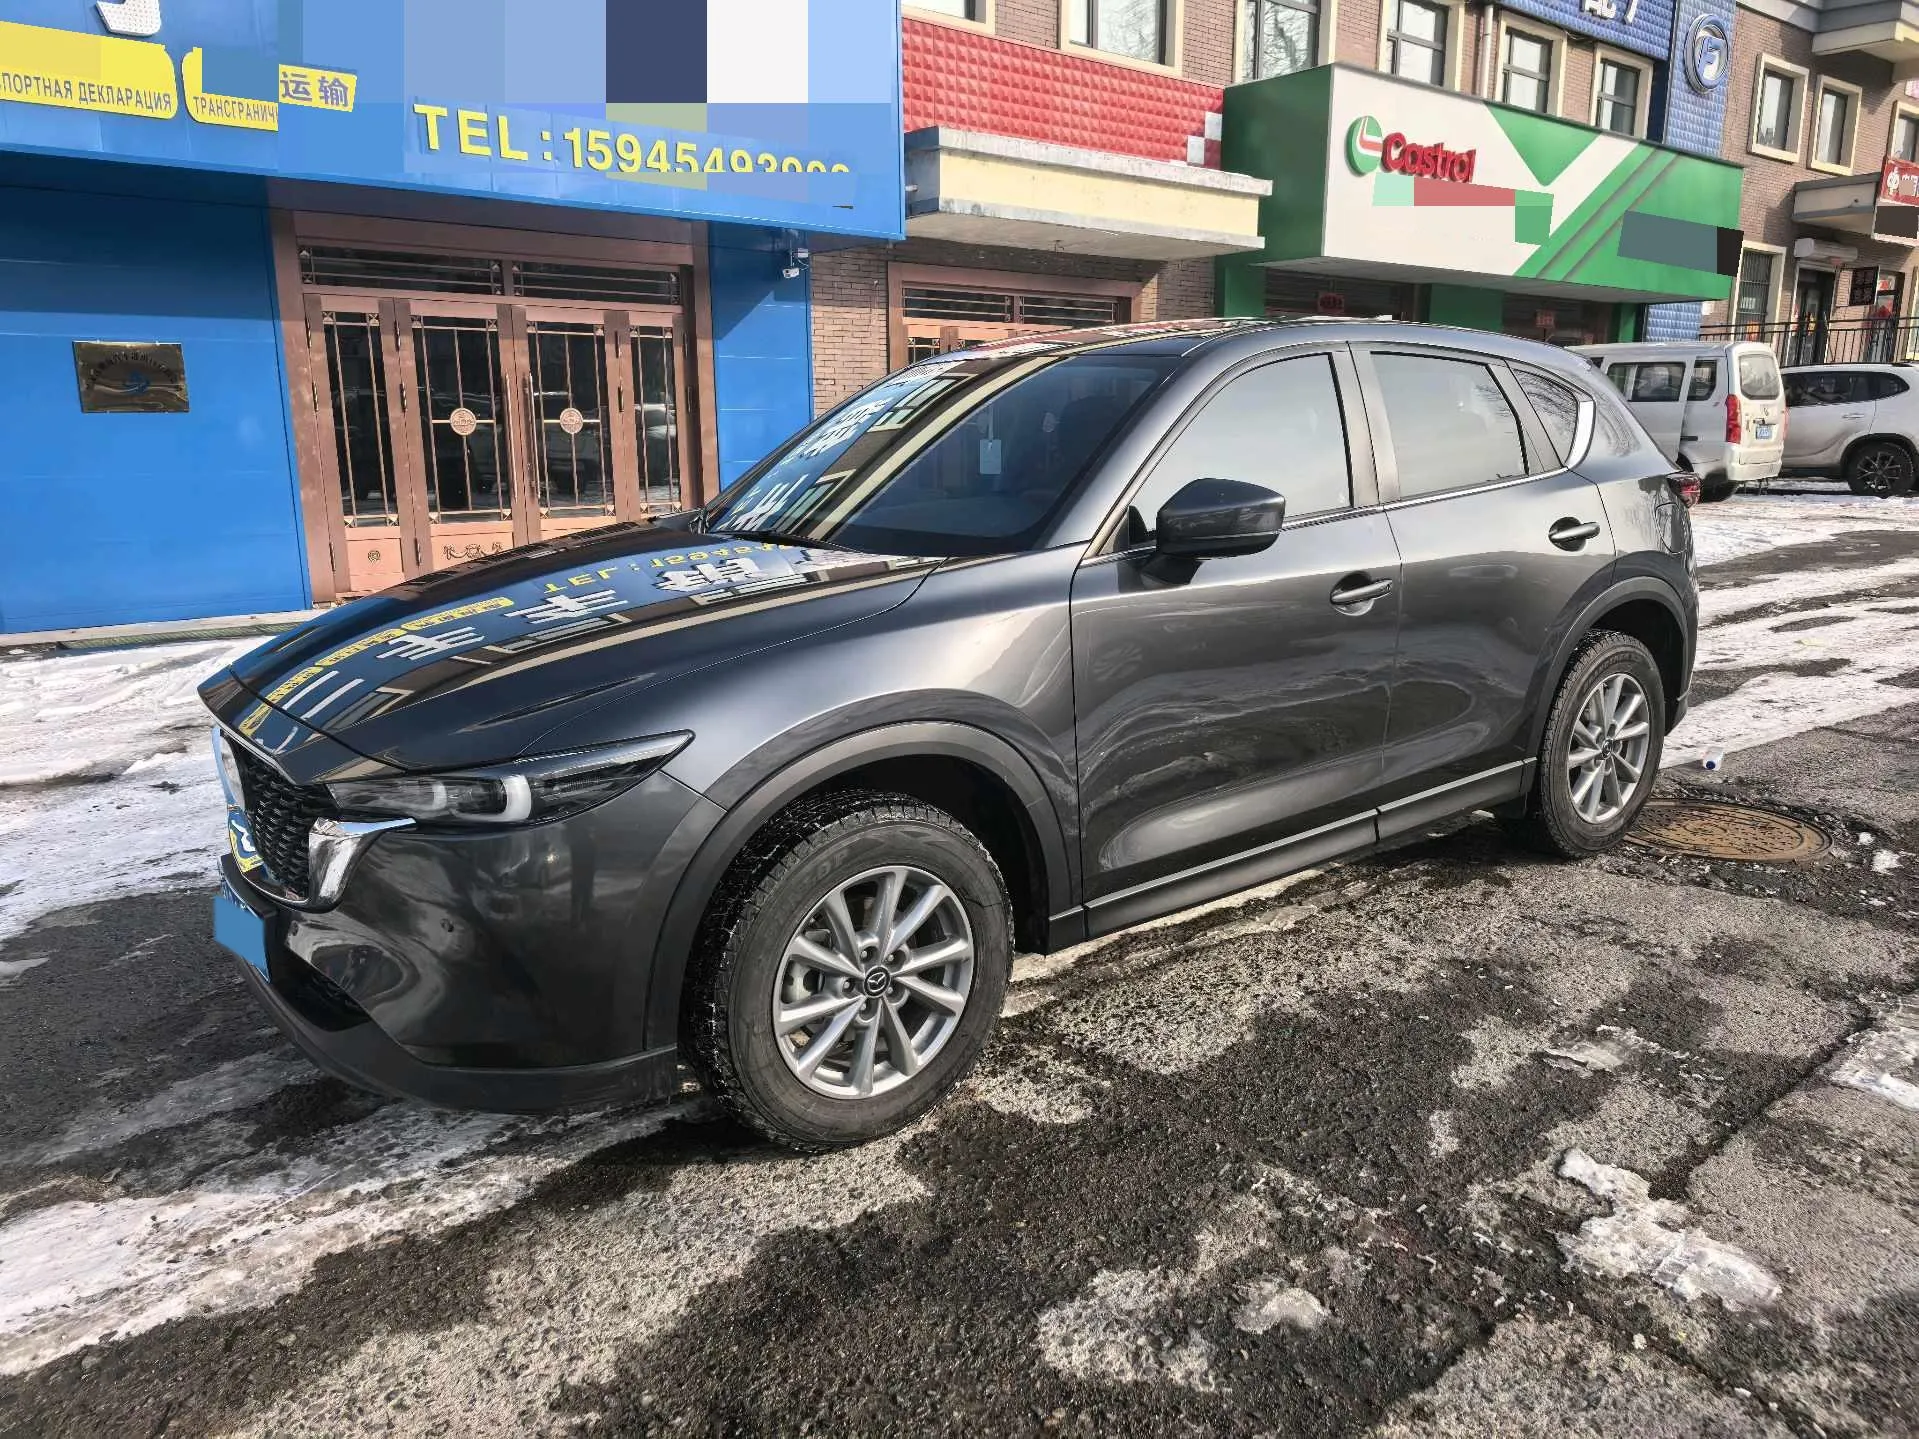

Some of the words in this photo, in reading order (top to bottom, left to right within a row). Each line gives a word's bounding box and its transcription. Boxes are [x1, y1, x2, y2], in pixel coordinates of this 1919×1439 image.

[0, 71, 73, 100] ПОРТНАЯ
[78, 81, 172, 112] ДЕКЛАРАЦИЯ
[279, 71, 349, 107] 运输
[193, 95, 278, 124] ТРАНСГРАНИЧ
[1381, 131, 1477, 183] Castrol
